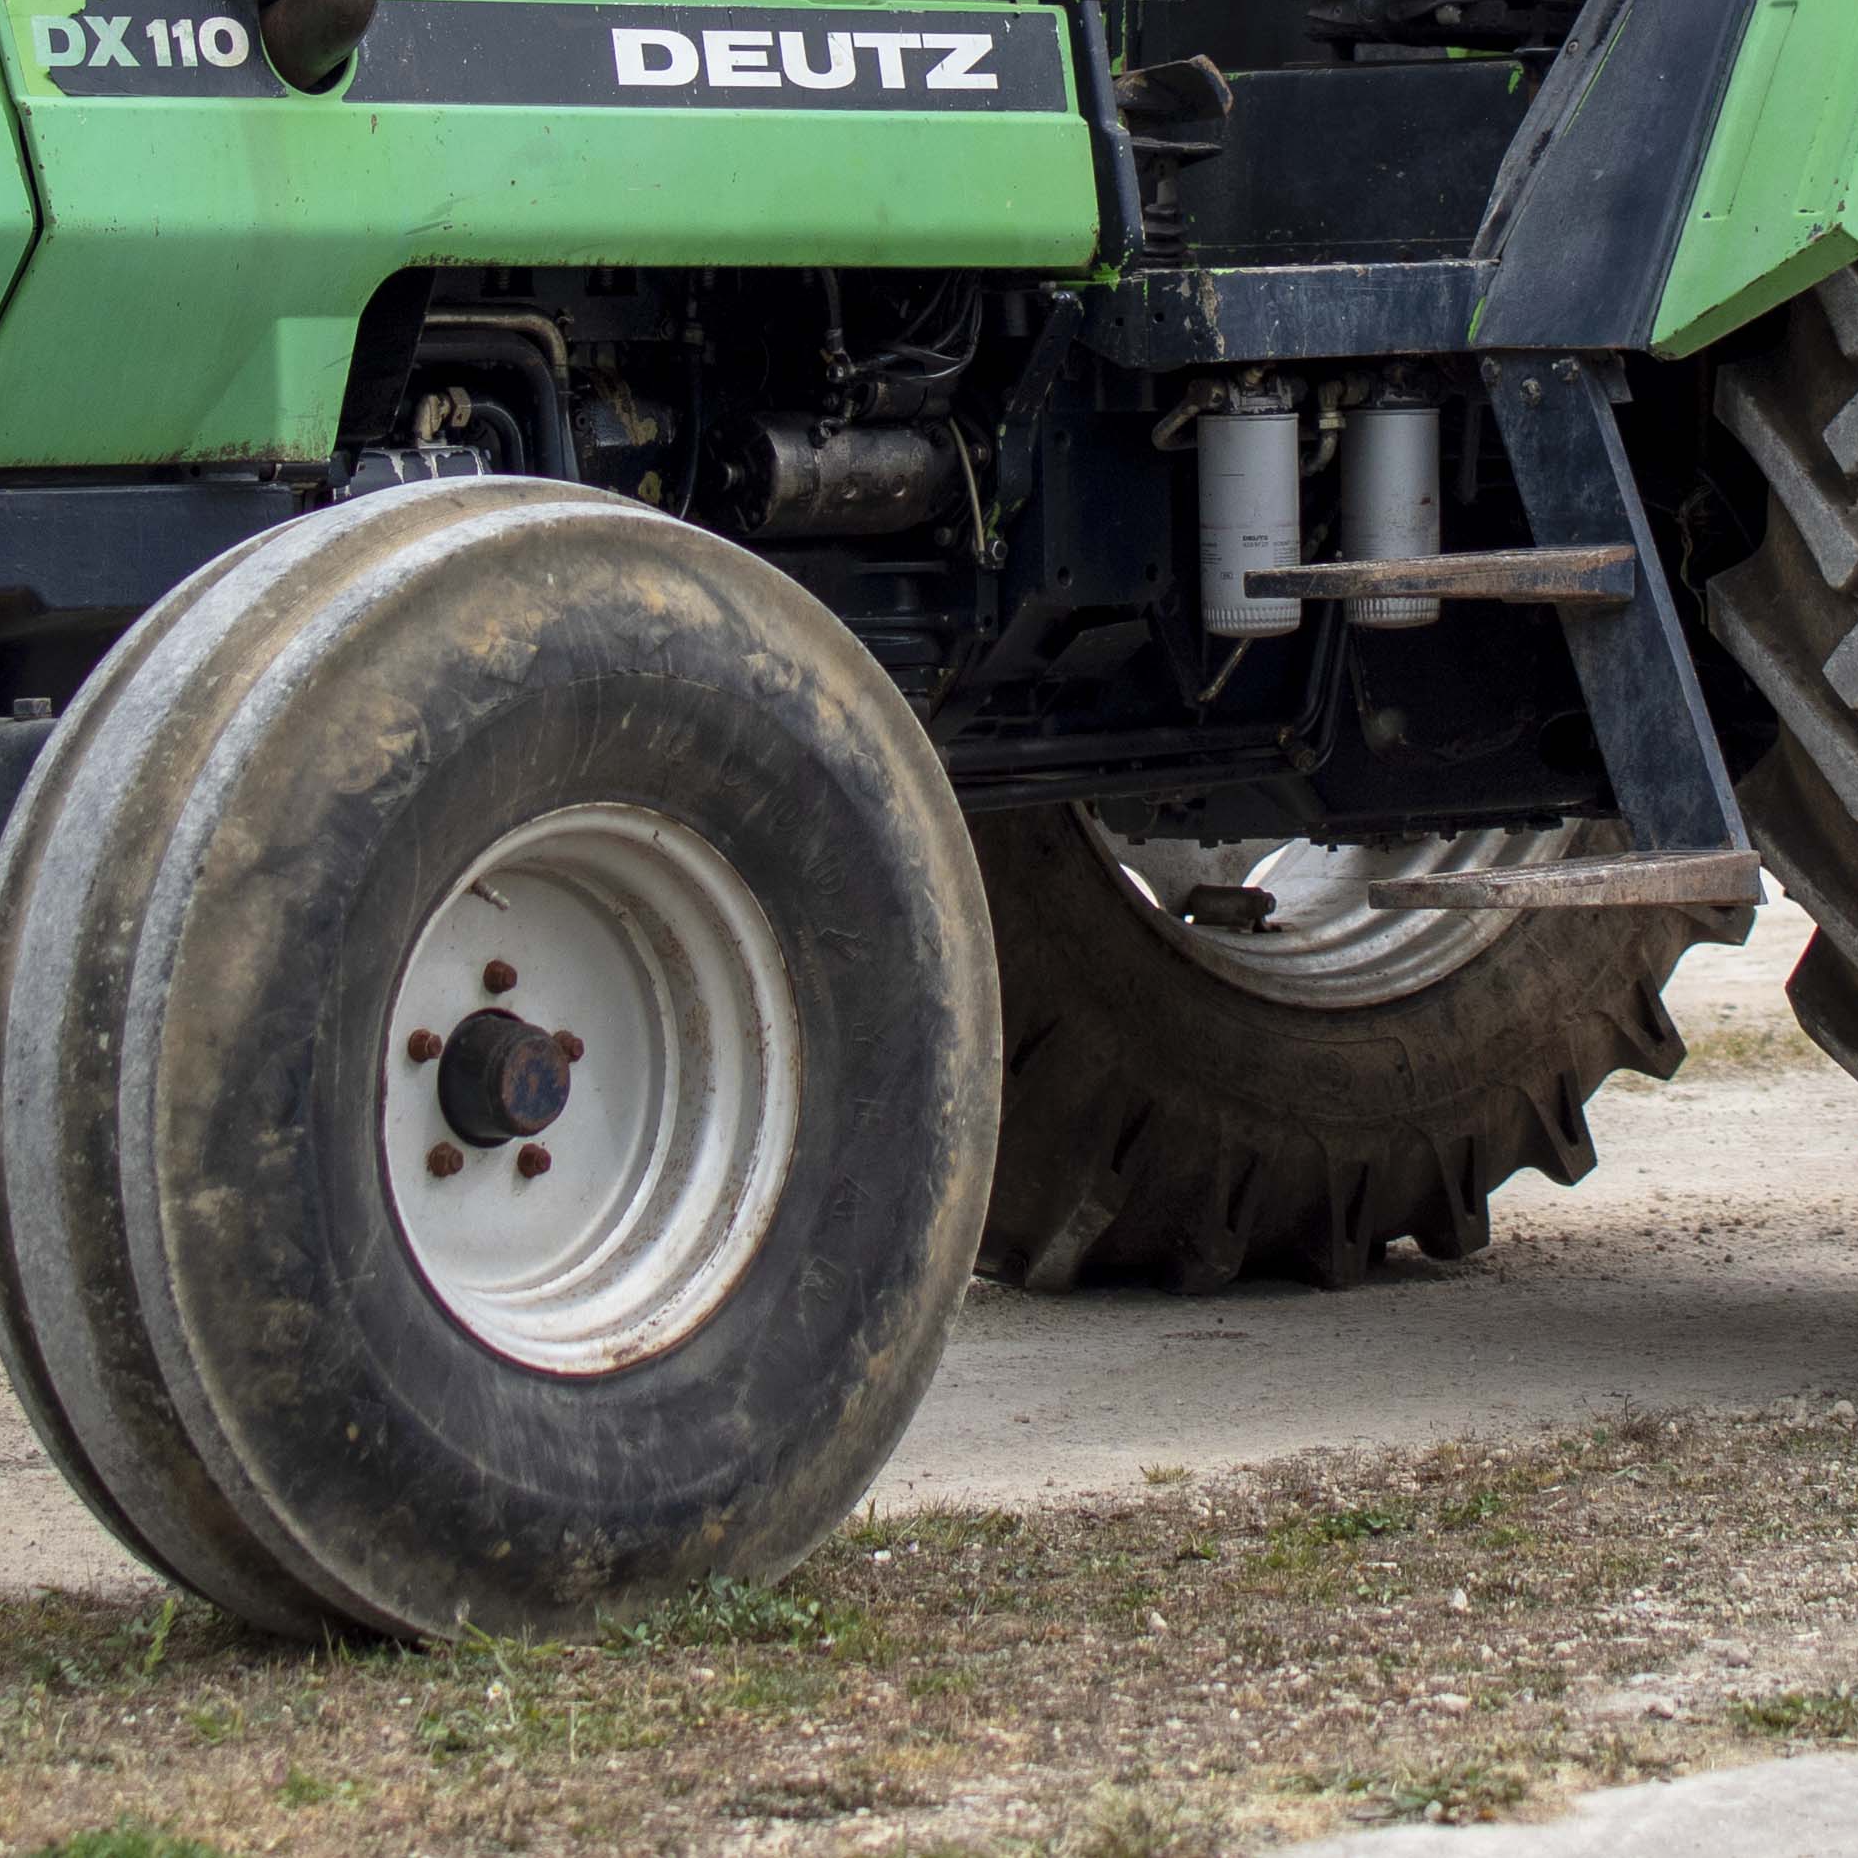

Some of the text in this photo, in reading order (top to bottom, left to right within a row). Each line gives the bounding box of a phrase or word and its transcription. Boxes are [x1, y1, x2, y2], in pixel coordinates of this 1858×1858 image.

[30, 15, 249, 68] DX 110
[611, 28, 999, 89] DEUTZ
